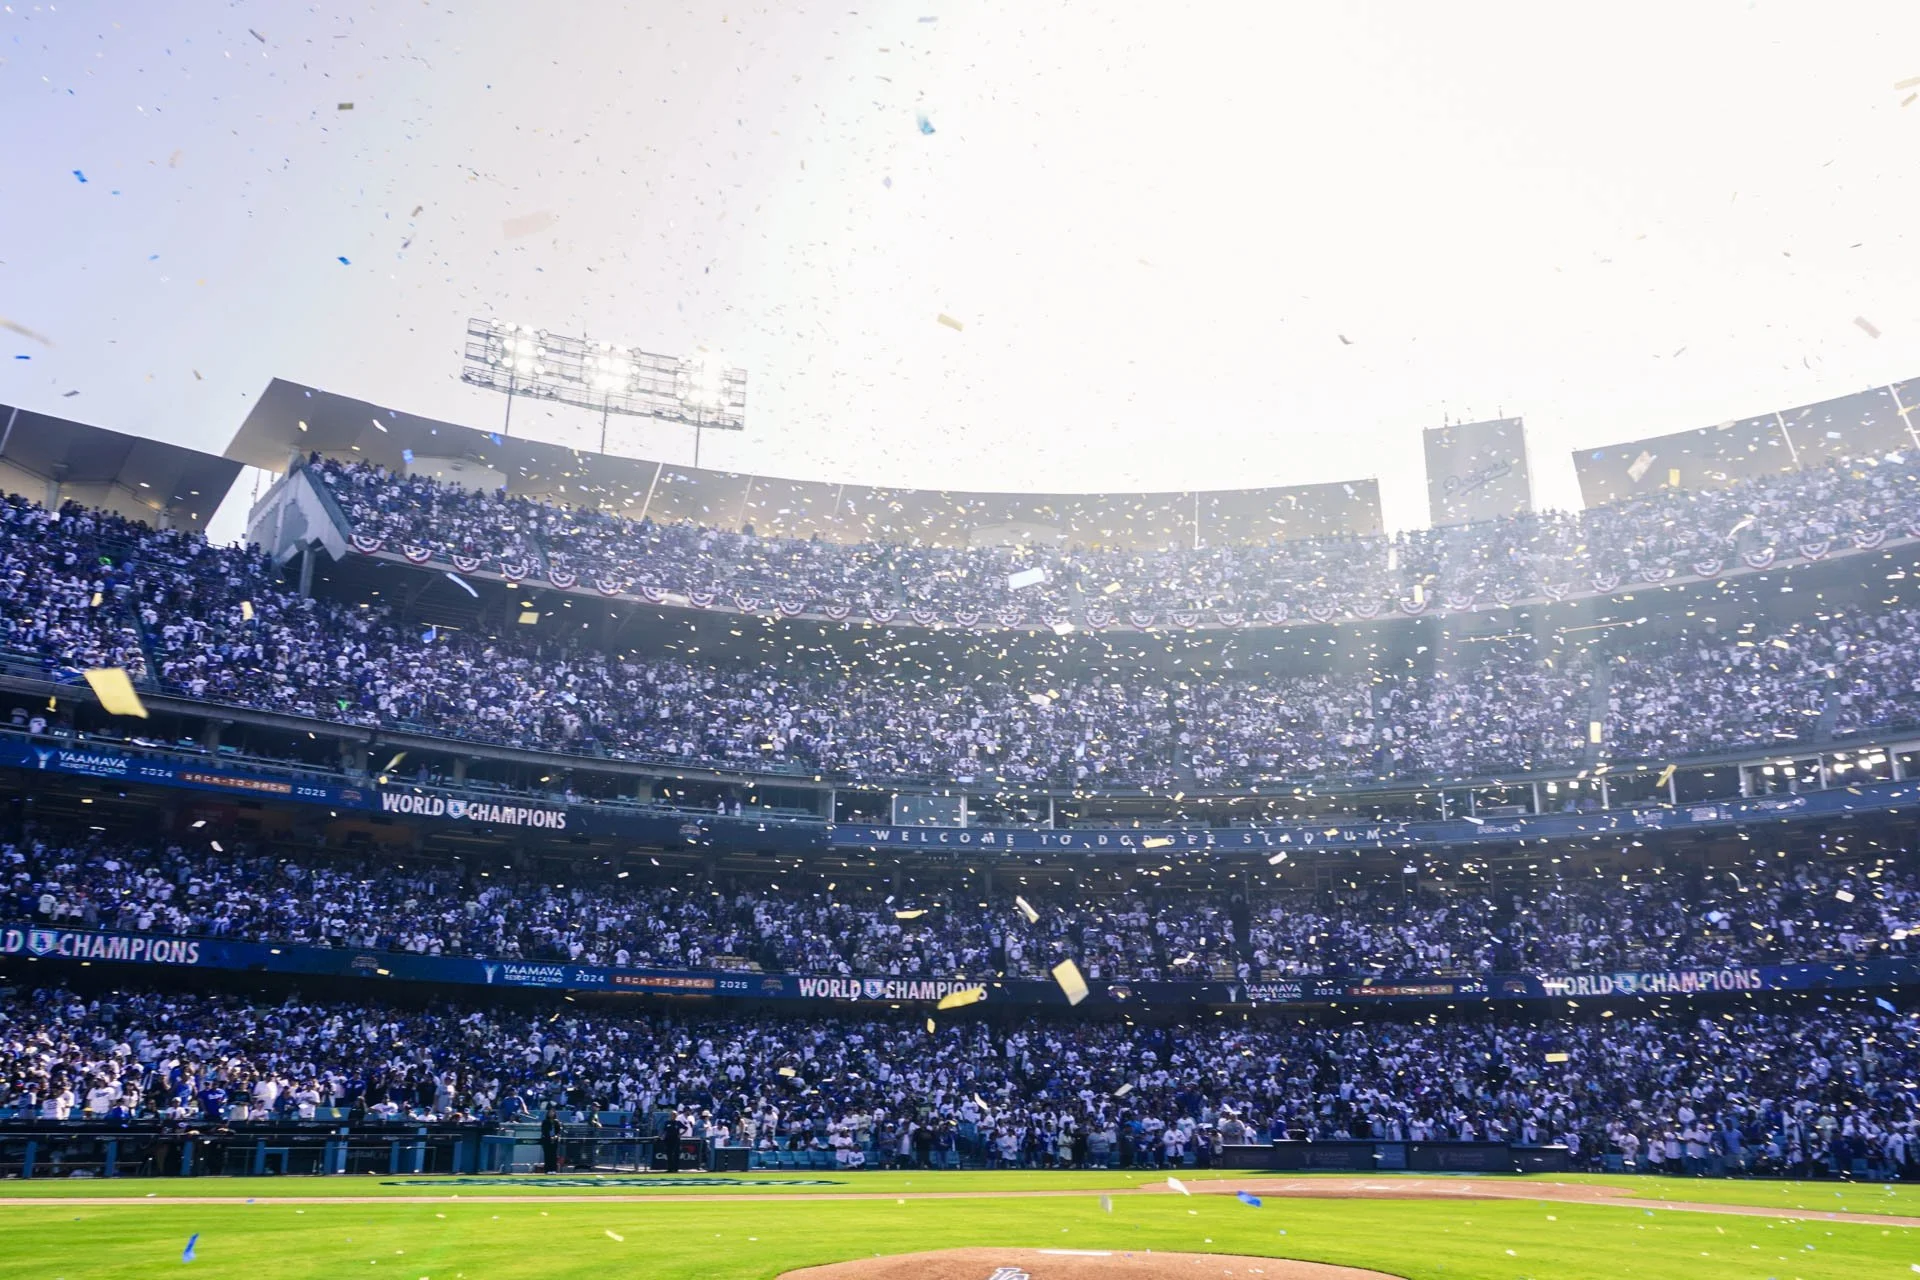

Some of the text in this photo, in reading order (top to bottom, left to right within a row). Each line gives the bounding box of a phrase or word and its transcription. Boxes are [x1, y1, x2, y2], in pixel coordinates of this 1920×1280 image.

[140, 767, 173, 778] 2024
[297, 787, 326, 797] 2025
[382, 792, 444, 816] WORLD
[468, 802, 566, 829] CHAMPIONS
[876, 830, 1014, 844] WELCOME
[1040, 834, 1072, 845] TO
[58, 933, 200, 964] CHAMPIONS
[575, 973, 604, 983] 2024
[720, 980, 748, 989] 2025
[799, 978, 861, 998] WORLD
[1543, 975, 1613, 996] WORLD
[1641, 969, 1762, 993] CHAMPIONS
